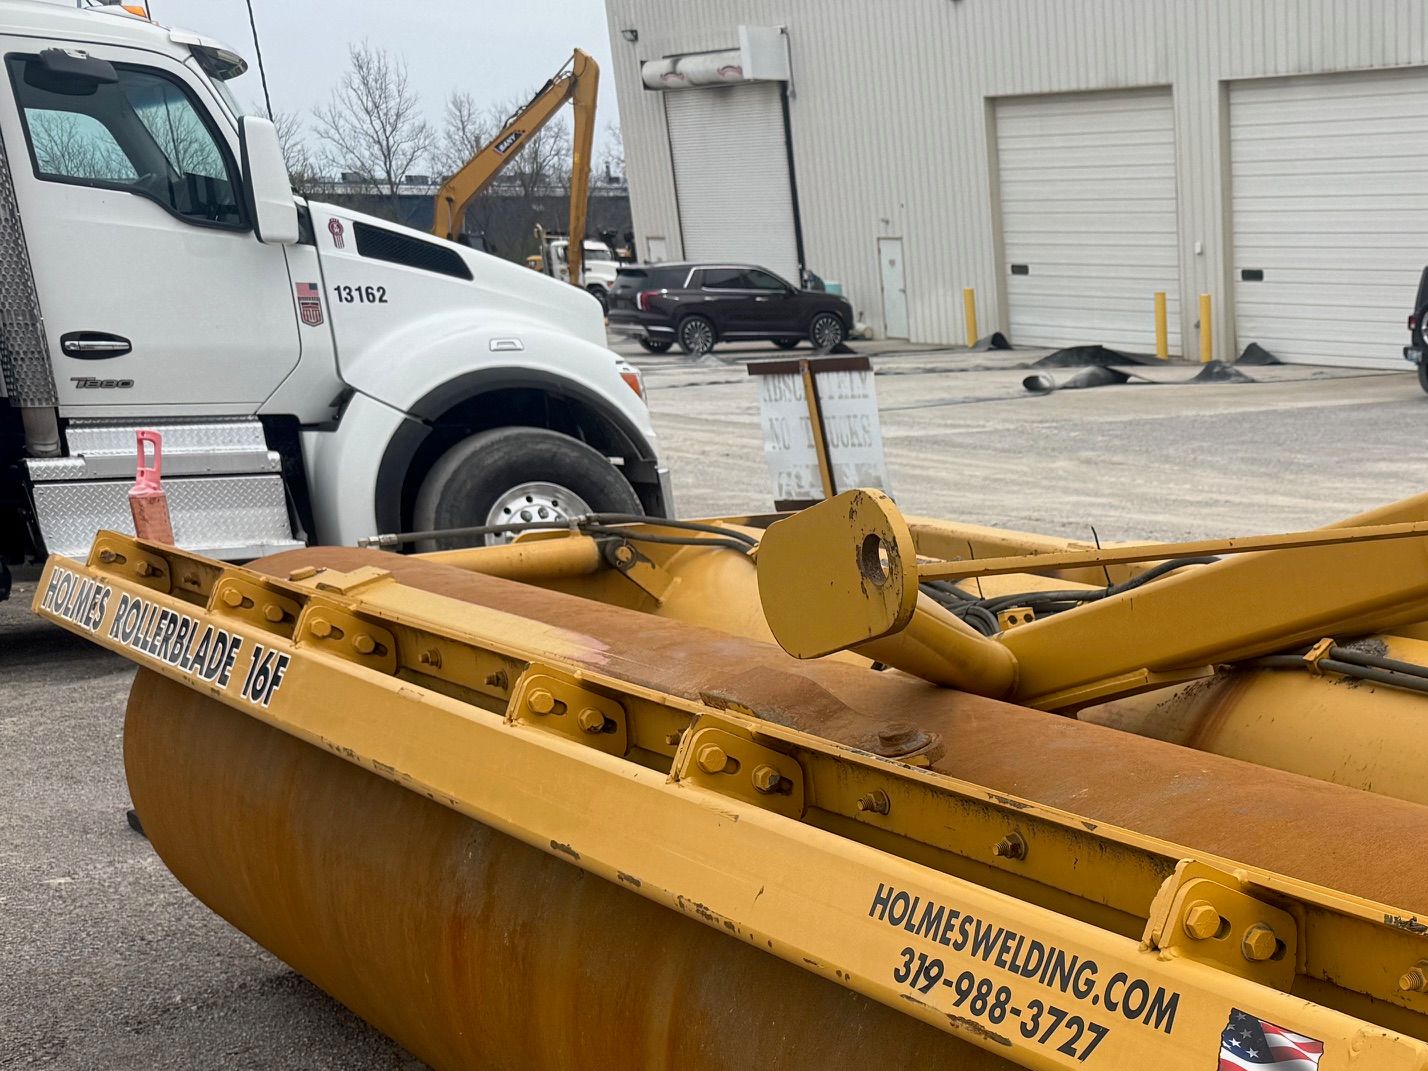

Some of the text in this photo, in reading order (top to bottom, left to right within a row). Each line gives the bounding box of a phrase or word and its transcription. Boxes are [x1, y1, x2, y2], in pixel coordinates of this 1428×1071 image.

[334, 285, 388, 303] 13162
[70, 377, 135, 389] T880
[800, 414, 873, 449] TUCKS
[41, 566, 292, 708] HOLMES ROLLERBLADE 16F
[868, 883, 1181, 1035] HOLMESWELDING.COM
[893, 947, 1110, 1063] 319-988-3727
